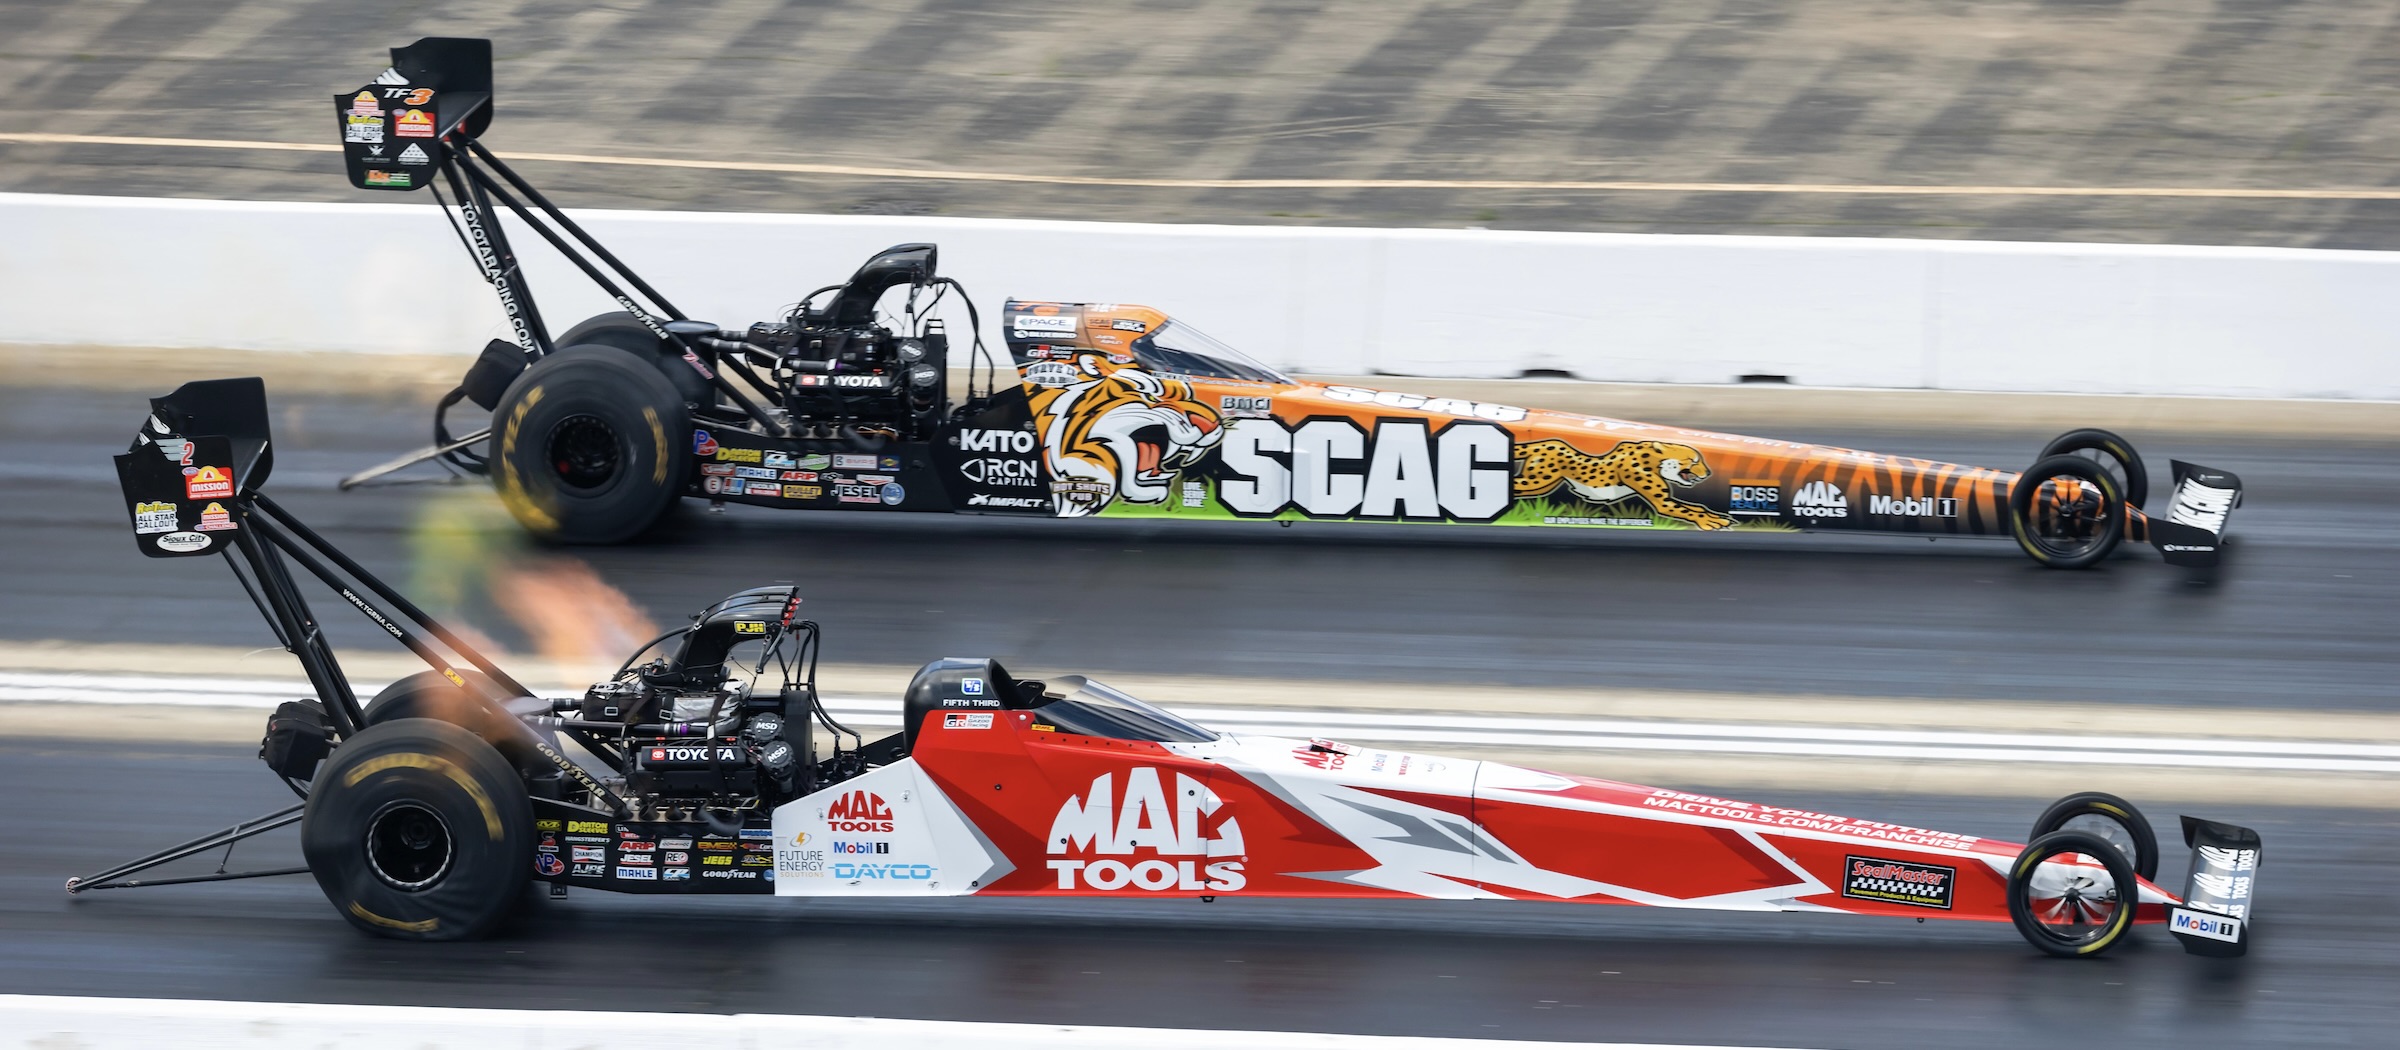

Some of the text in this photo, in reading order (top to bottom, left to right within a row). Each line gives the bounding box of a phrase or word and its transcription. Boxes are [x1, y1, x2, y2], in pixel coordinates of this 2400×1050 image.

[384, 88, 435, 105] TF3
[461, 201, 536, 354] TOYOTARACING.COM
[617, 295, 670, 340] GOODYEAR
[1029, 318, 1067, 326] PACE
[1027, 348, 1049, 359] GR
[816, 375, 883, 387] TYOTA
[1321, 385, 1530, 422] SCAG
[960, 429, 1034, 453] KATO
[181, 441, 195, 466] 2
[737, 468, 776, 479] MAHLE
[987, 459, 1038, 478] RCN
[1219, 418, 1511, 521] SCAG
[781, 472, 817, 480] ARP
[988, 476, 1038, 487] CAPITAL
[830, 485, 880, 500] JESEL
[1053, 483, 1110, 495] HOT SHOTS
[1731, 487, 1779, 502] BOSS
[1792, 480, 1848, 507] MAC
[1069, 492, 1093, 501] PUB
[1792, 506, 1848, 517] TOOLS
[1870, 495, 1933, 516] Mobil
[163, 534, 207, 543] Sioux City
[943, 699, 1001, 707] FIFTH THIRD
[755, 722, 778, 732] MSD
[945, 718, 967, 728] GR
[767, 746, 788, 763] MSD
[535, 742, 606, 798] GOODYEAR
[827, 790, 894, 821] MAC
[1046, 767, 1246, 858] MAC
[1650, 789, 1982, 844] DRIVE YOUR FUTURE
[567, 820, 608, 833] DARTON
[828, 821, 895, 833] TOOLS
[1642, 796, 1974, 852] MACTOOLS.COM/FRANCHISE
[620, 842, 656, 851] ARP
[833, 841, 889, 855] Mobil 1
[574, 851, 603, 859] CHAMPION
[620, 854, 654, 863] JESEL
[703, 855, 733, 865] JEGS
[779, 850, 824, 861] FUTURE
[779, 861, 825, 872] ENERGY
[828, 863, 938, 880] DAYCO
[1851, 860, 1944, 886] SealMaster
[618, 869, 653, 878] MAHLE
[702, 869, 757, 880] GOODYEAR
[1046, 860, 1248, 892] TOOLS
[2176, 914, 2233, 936] Mobil 1
